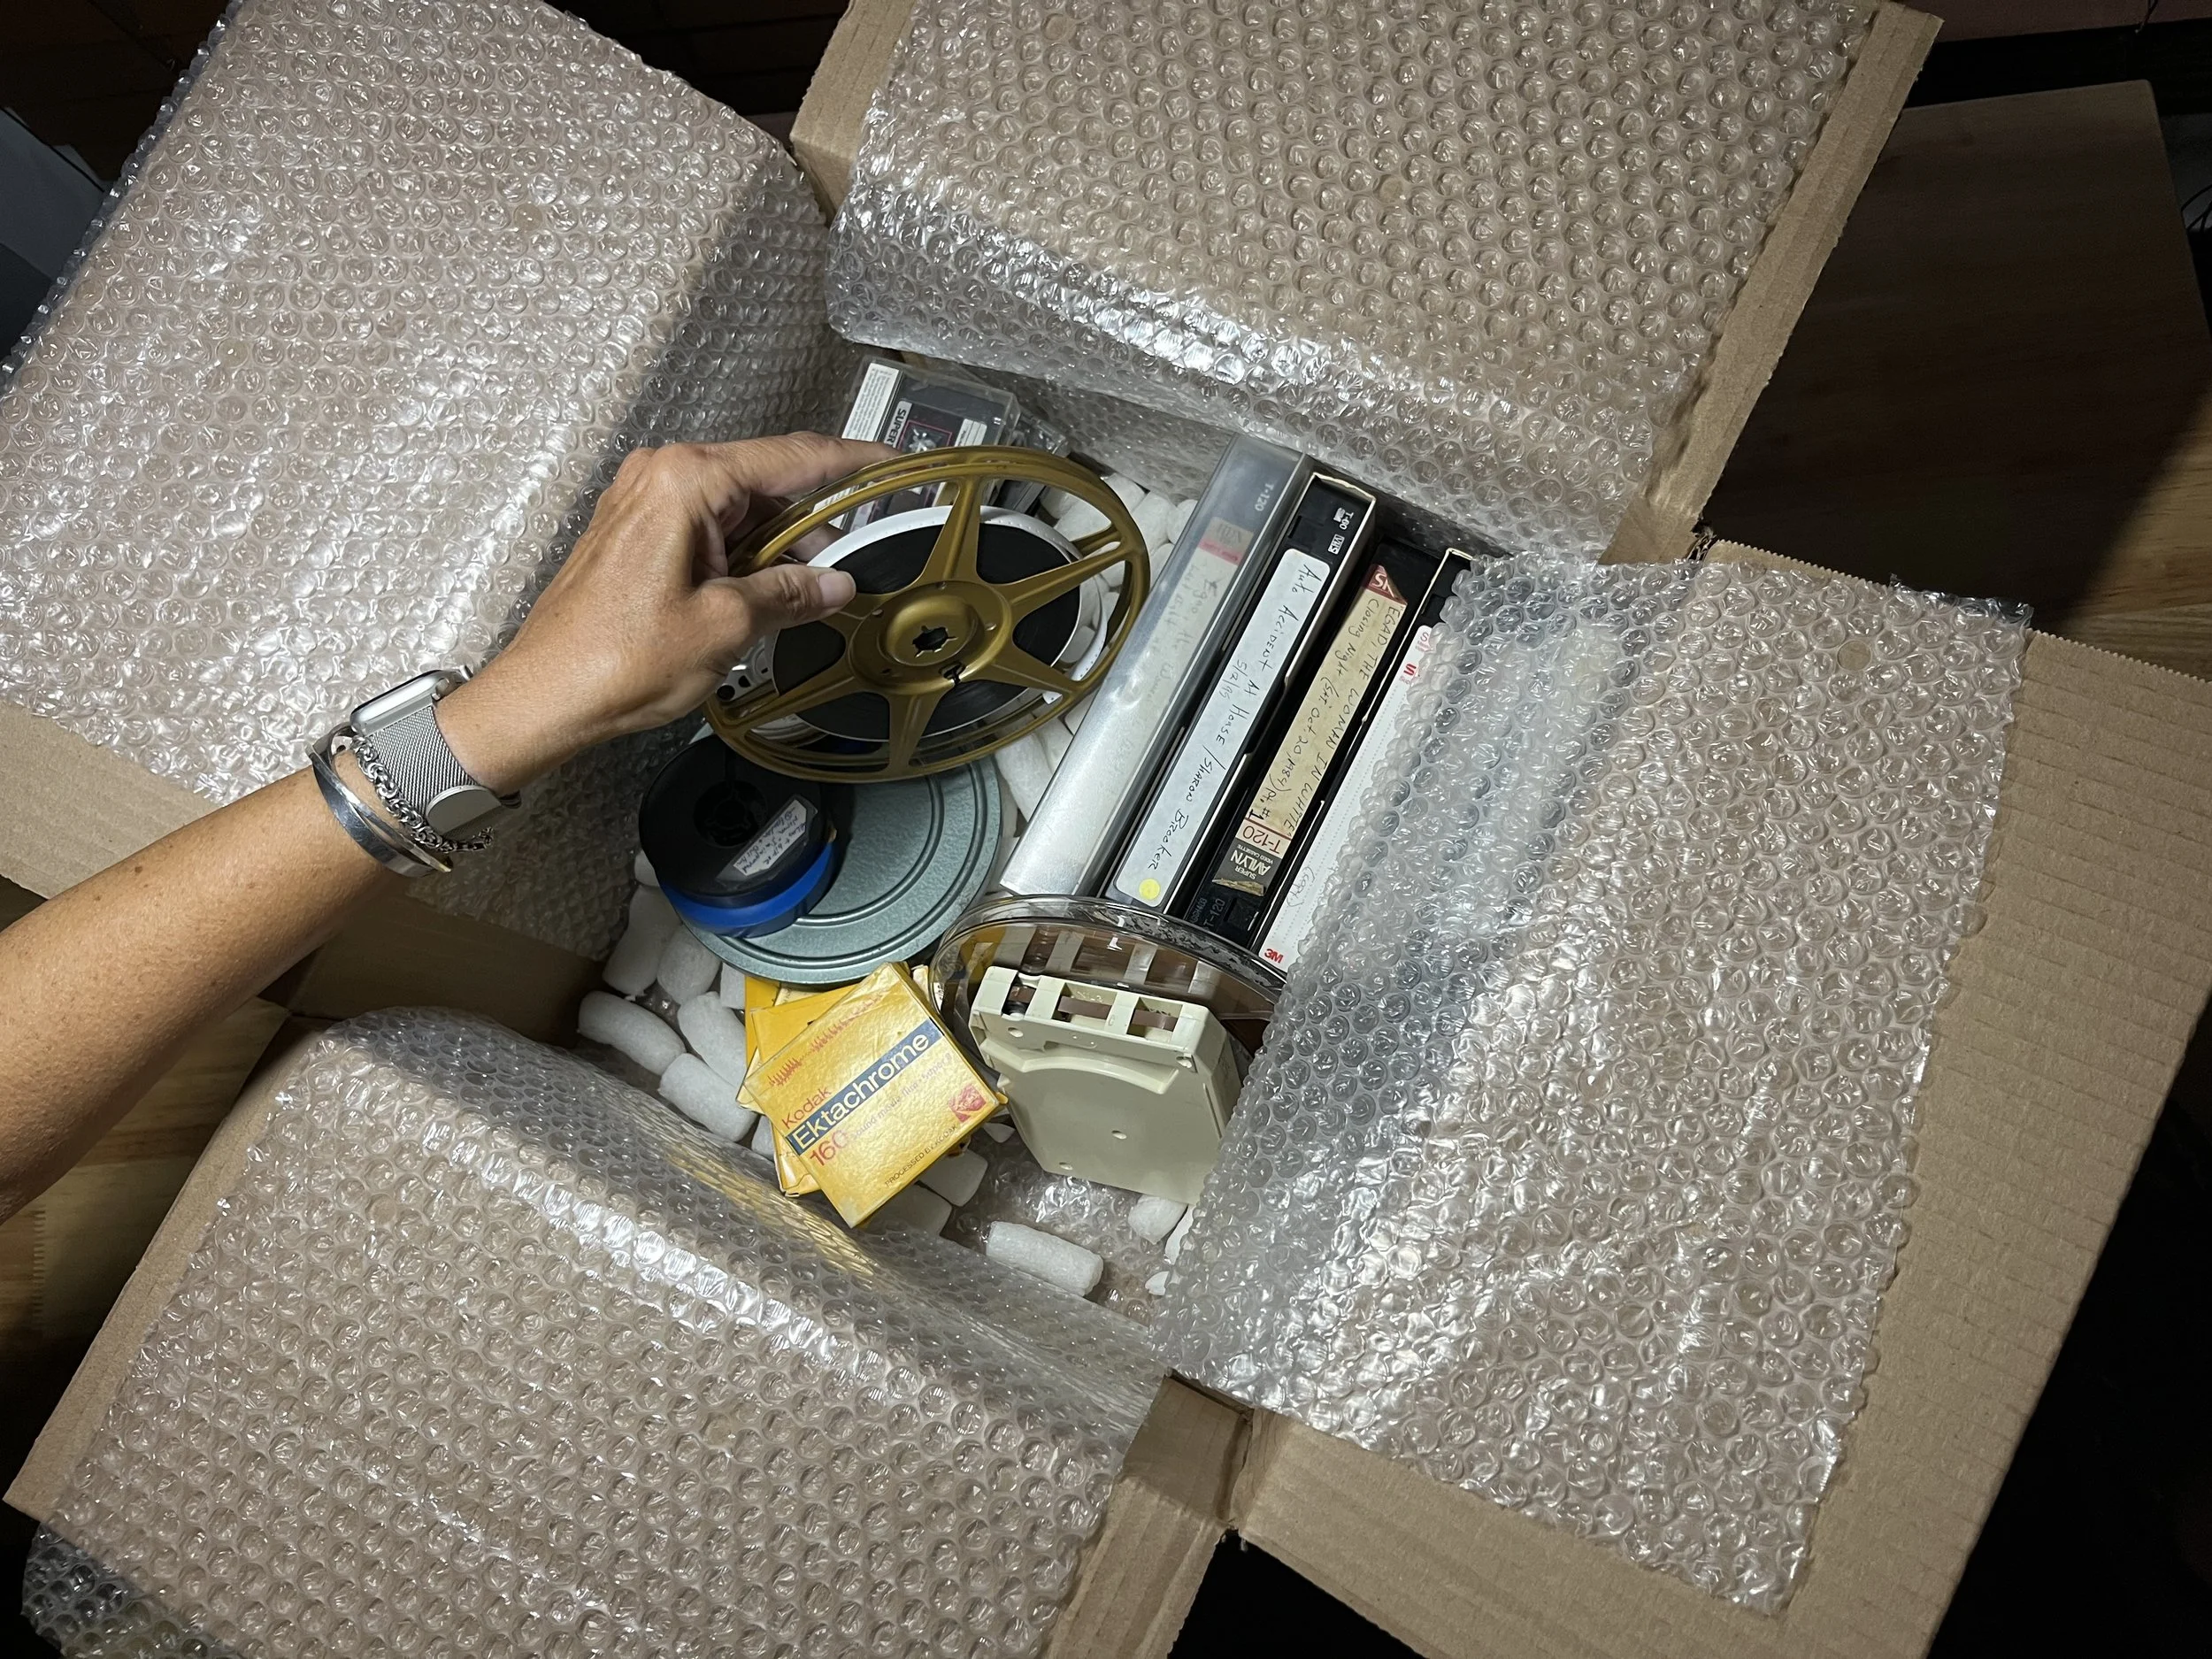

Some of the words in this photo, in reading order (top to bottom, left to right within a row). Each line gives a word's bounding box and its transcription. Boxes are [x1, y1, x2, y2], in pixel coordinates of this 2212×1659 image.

[884, 407, 907, 446] SUPER
[1252, 480, 1276, 512] T-120
[1326, 533, 1346, 556] VHS
[1287, 563, 1325, 602] Auto
[1345, 593, 1384, 641] Closing
[1324, 637, 1359, 679] Night
[1355, 651, 1379, 682] THE
[1321, 687, 1363, 749] WOMAN
[1307, 751, 1331, 780] IN
[1236, 843, 1260, 857] CASSETTE
[1240, 824, 1285, 854] T-120
[1229, 849, 1271, 877] AVILYN
[1233, 864, 1256, 879] SUPER
[1259, 854, 1274, 864] VIDEO
[1202, 896, 1226, 929] T-120
[1263, 947, 1284, 964] 3M
[789, 1030, 934, 1150] Ektachrome
[780, 1084, 833, 1130] Kodak
[806, 1126, 853, 1170] 160
[883, 1151, 926, 1187] PROCESSED
[931, 1123, 958, 1147] KODAK
